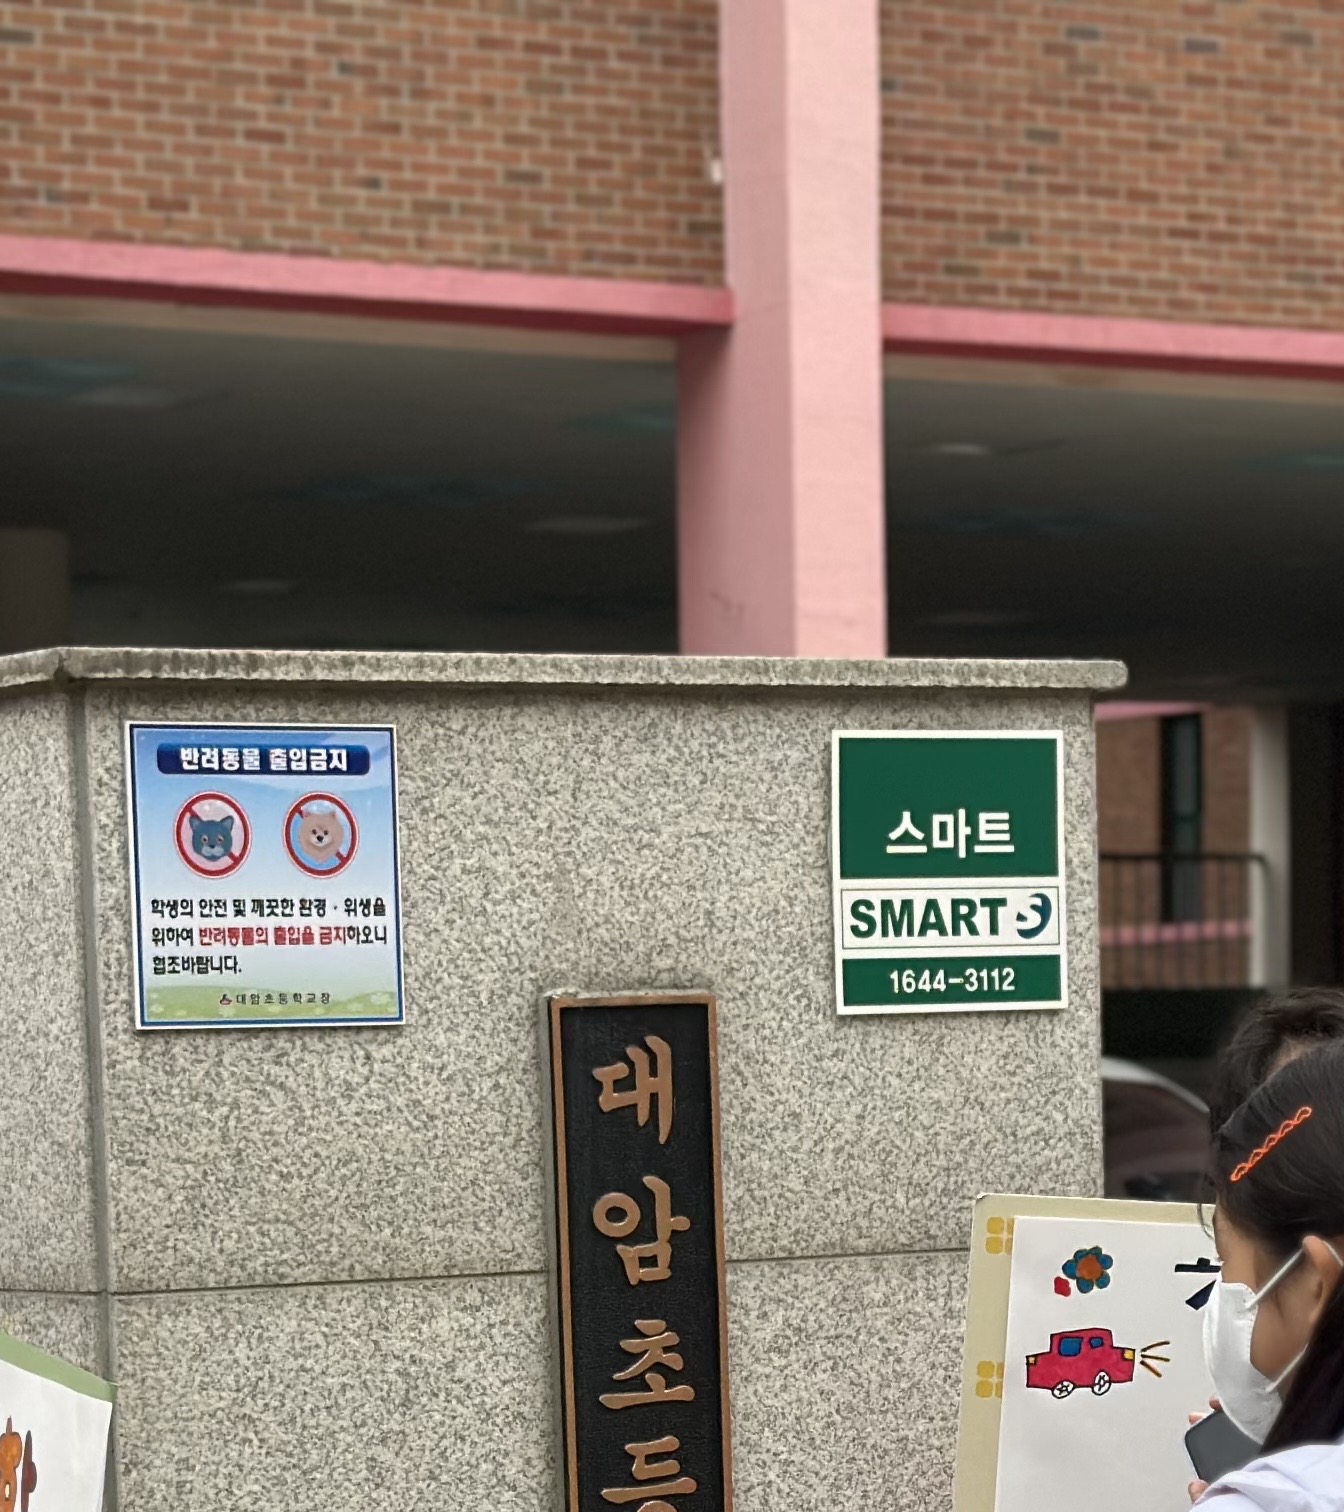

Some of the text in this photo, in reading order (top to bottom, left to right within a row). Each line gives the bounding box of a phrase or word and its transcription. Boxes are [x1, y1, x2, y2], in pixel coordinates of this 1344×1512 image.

[180, 748, 347, 771] 반려동물 출입금지
[886, 808, 1015, 858] 스마트
[151, 898, 193, 918] 학생의
[199, 898, 227, 918] 안전
[233, 898, 246, 917] 및
[251, 898, 294, 917] 깨끗한
[299, 897, 327, 917] 환경
[344, 897, 386, 917] 위생을
[850, 897, 1007, 939] SMART
[151, 925, 387, 947] 위하여 반려동물의 출입을 금지하오니
[152, 955, 242, 976] 협조바랍니다.
[890, 967, 1015, 993] 1644-3112
